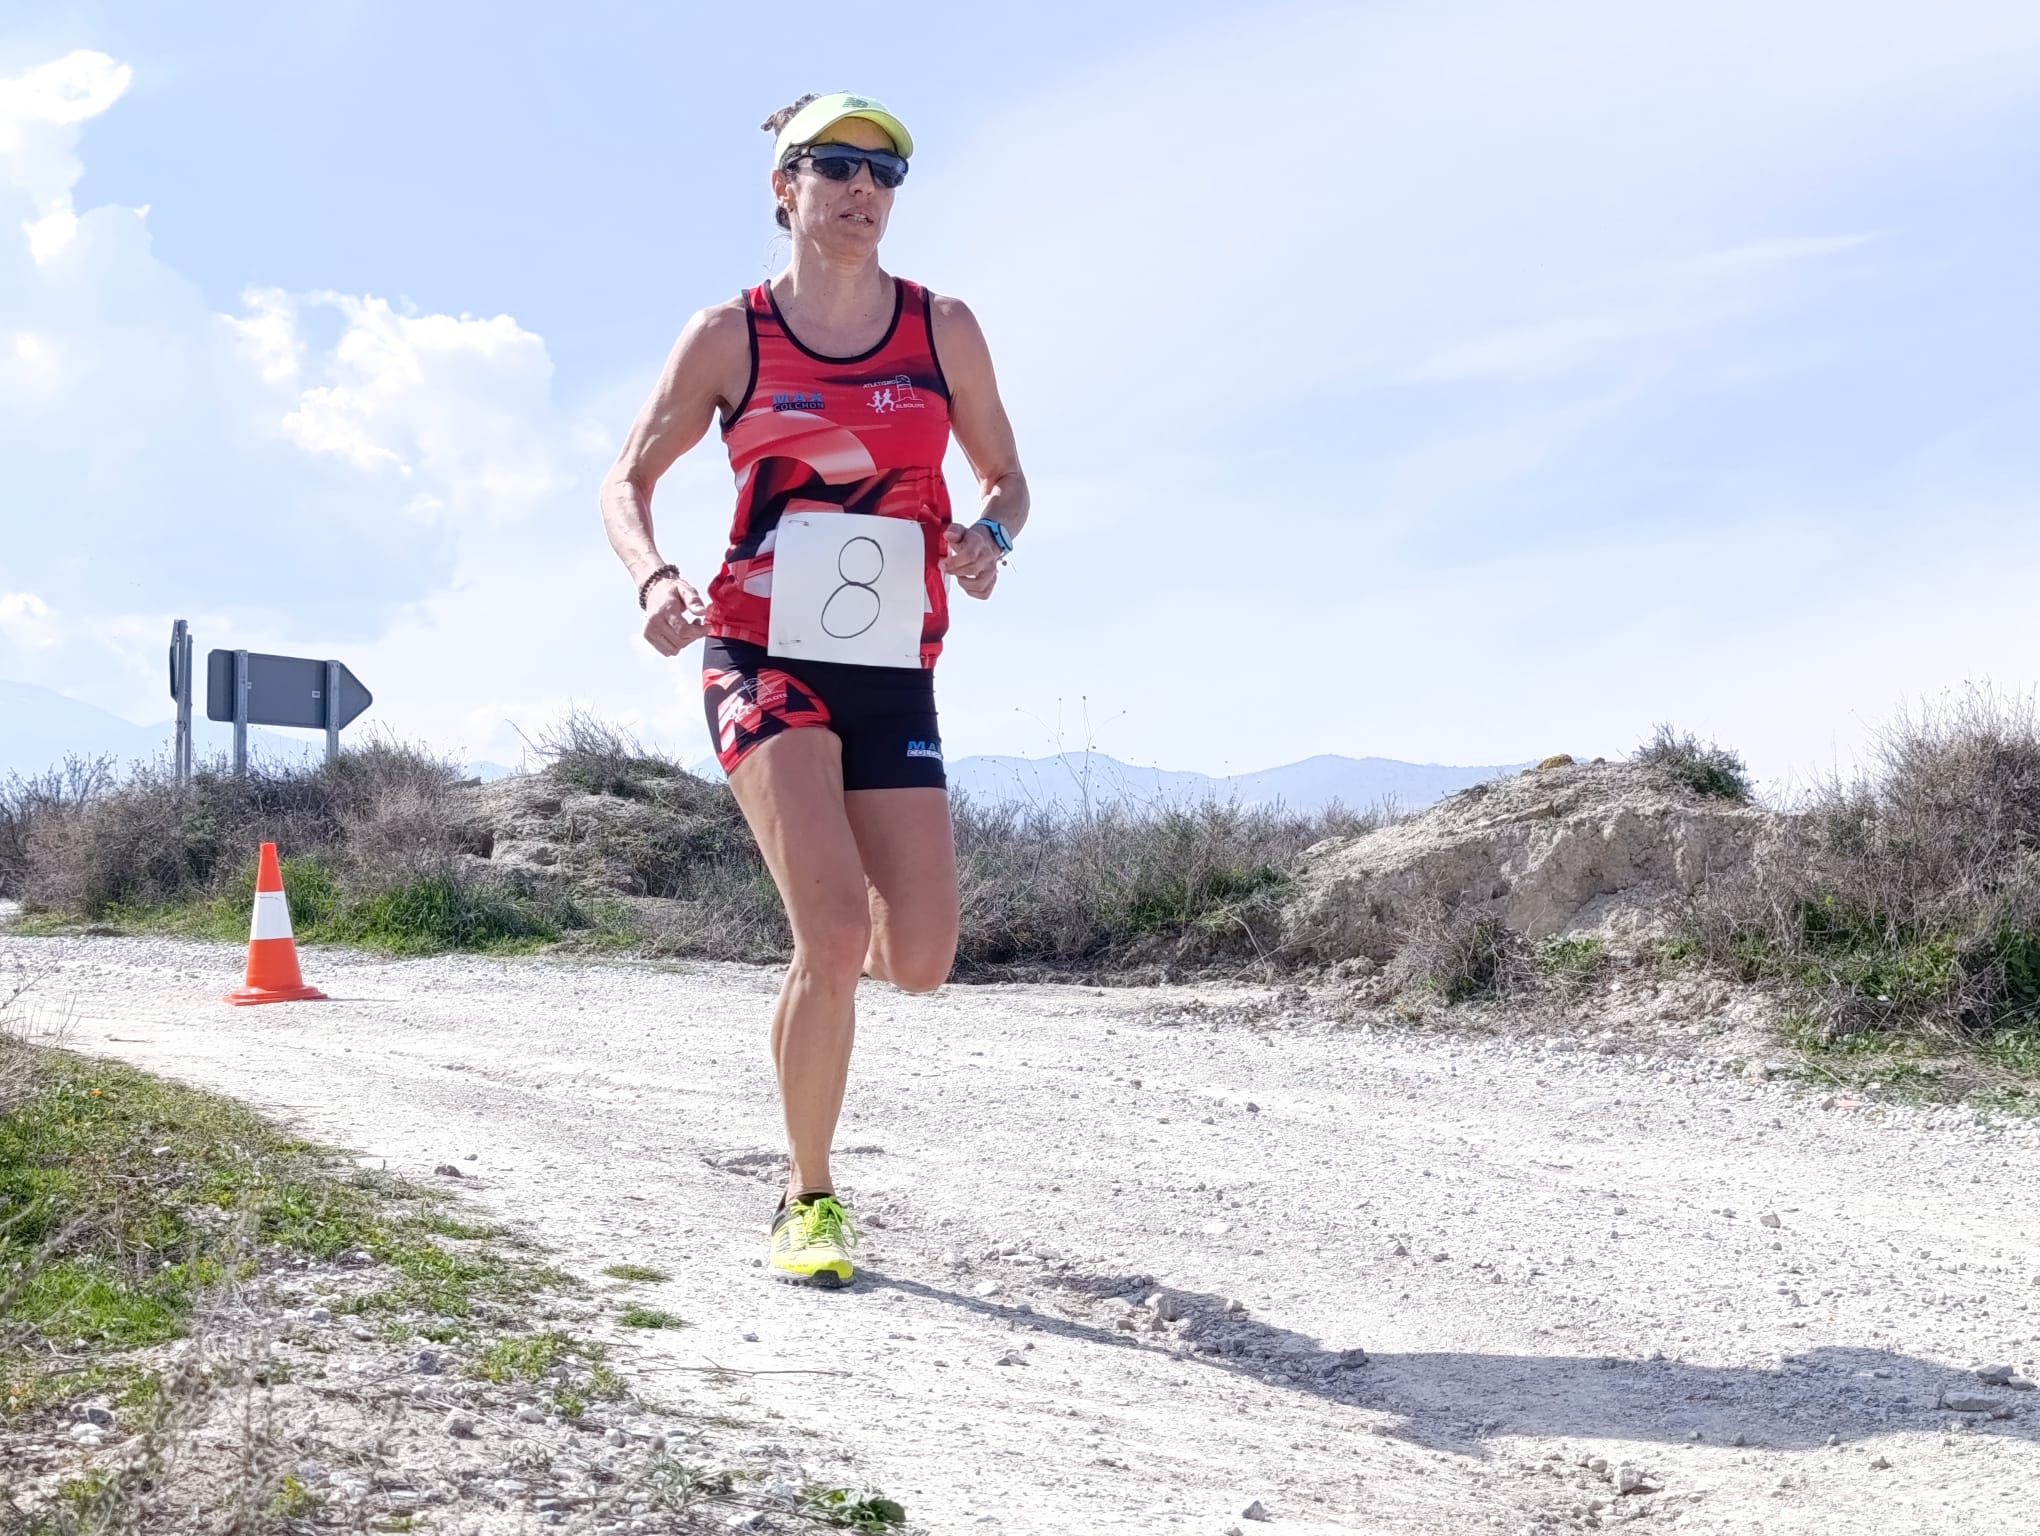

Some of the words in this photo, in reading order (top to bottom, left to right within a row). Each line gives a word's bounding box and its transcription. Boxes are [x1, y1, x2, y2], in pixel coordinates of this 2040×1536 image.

[773, 393, 823, 404] MAX
[774, 401, 825, 412] COLCHON
[821, 536, 884, 639] 8
